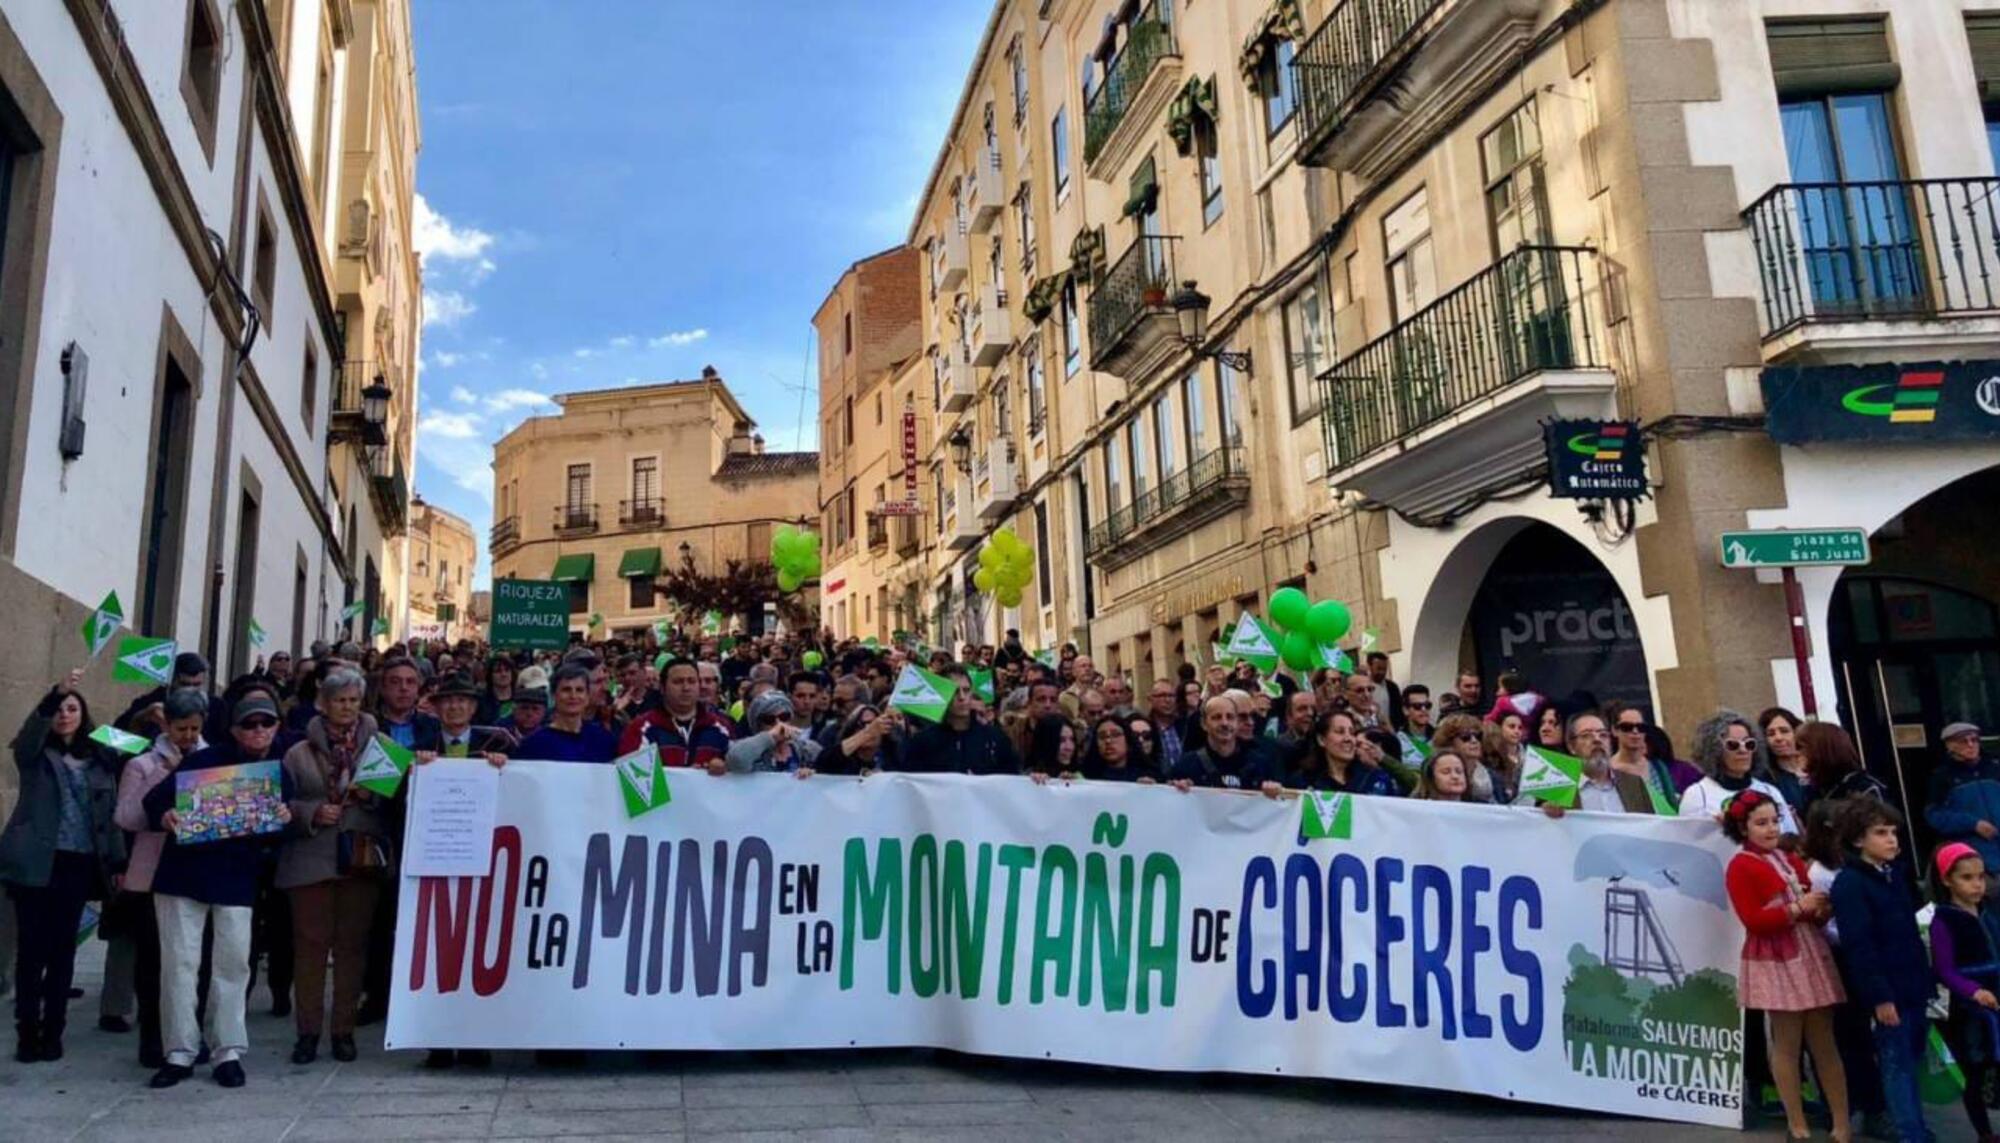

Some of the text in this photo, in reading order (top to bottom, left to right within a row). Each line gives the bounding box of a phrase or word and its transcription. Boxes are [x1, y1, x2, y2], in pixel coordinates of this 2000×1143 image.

[1790, 550, 1819, 560] San
[1793, 534, 1858, 547] plaza de
[500, 583, 563, 600] RIQUEZA
[497, 613, 564, 627] NATURALEZA
[524, 855, 548, 907] A
[779, 863, 819, 915] EN
[409, 825, 522, 997] NO
[572, 832, 774, 997] MINA
[839, 811, 1181, 1014] MONTAÑA
[1191, 908, 1231, 963] DE
[527, 913, 569, 969] LA
[797, 920, 834, 975] LA
[1642, 1018, 1743, 1055] SALVEMOS
[1606, 1044, 1743, 1094] MONTAÑA
[1637, 1083, 1659, 1099] de
